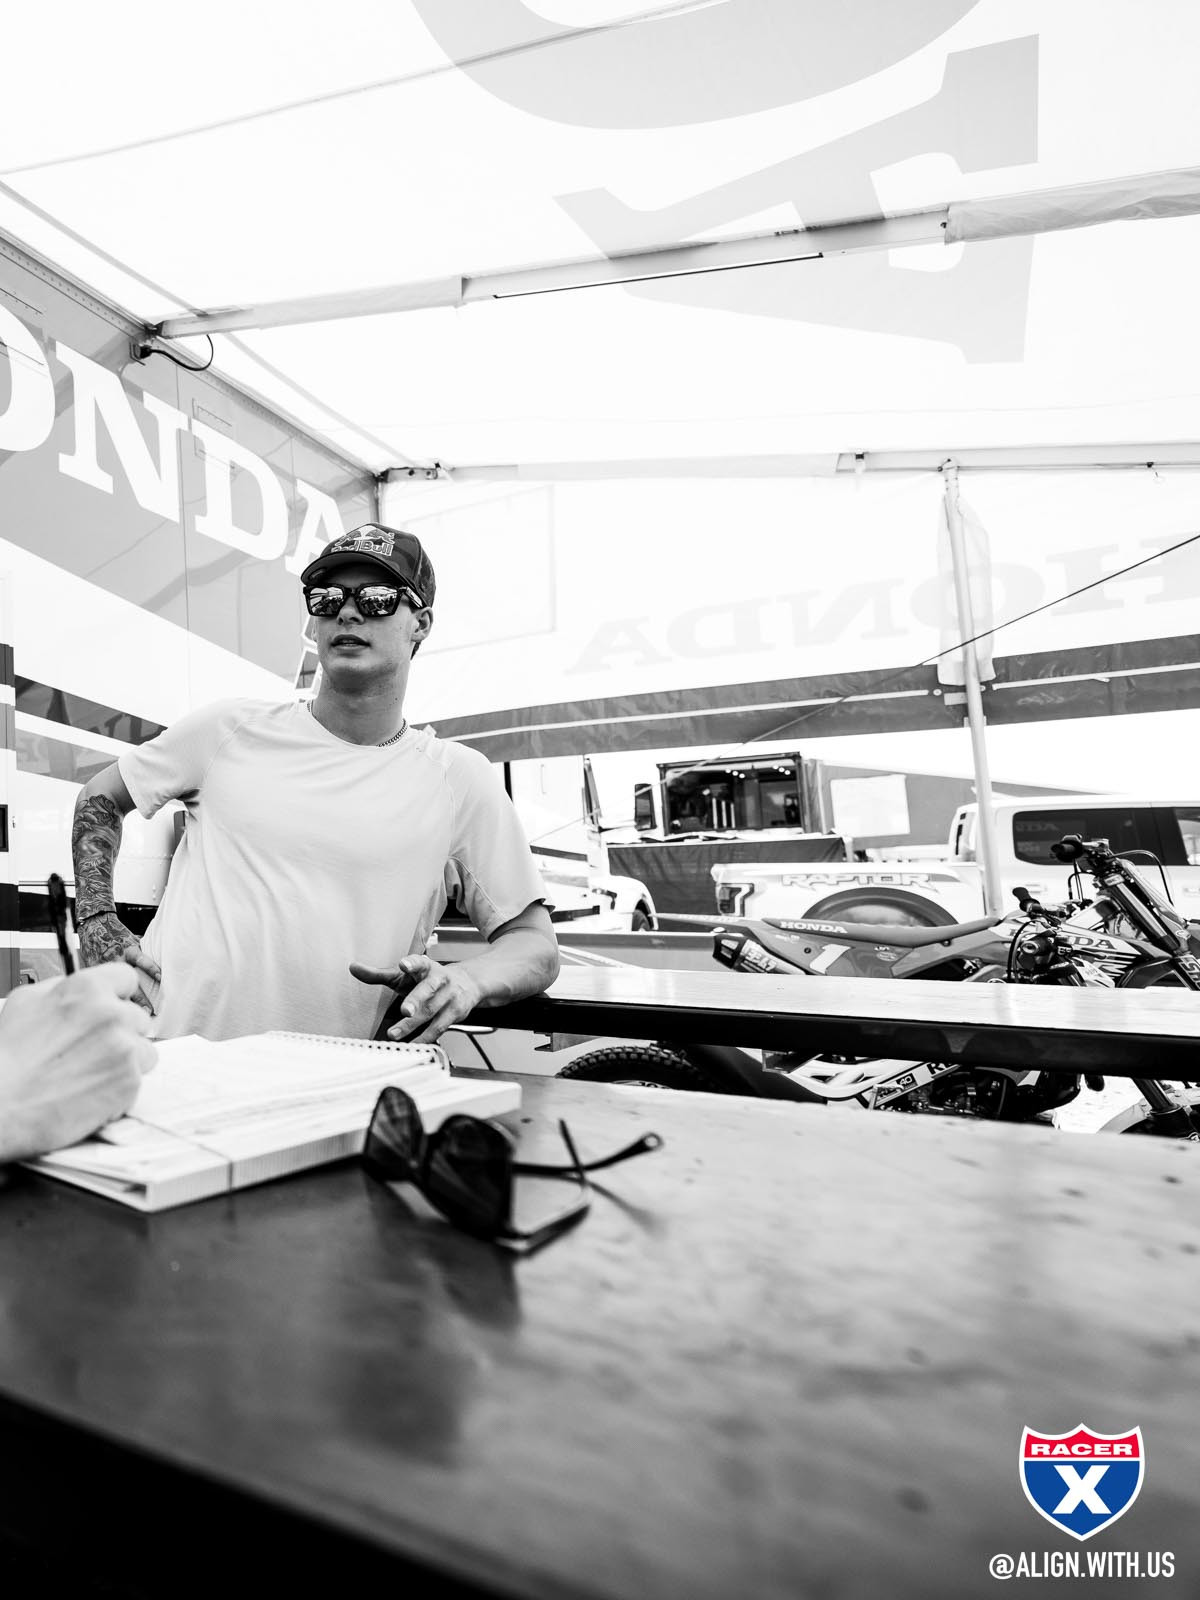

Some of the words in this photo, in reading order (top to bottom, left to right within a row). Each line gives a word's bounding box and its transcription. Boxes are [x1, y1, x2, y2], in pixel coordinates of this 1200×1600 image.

[360, 540, 394, 557] Bull
[781, 872, 939, 893] RAPTOR
[779, 921, 848, 934] HONDA
